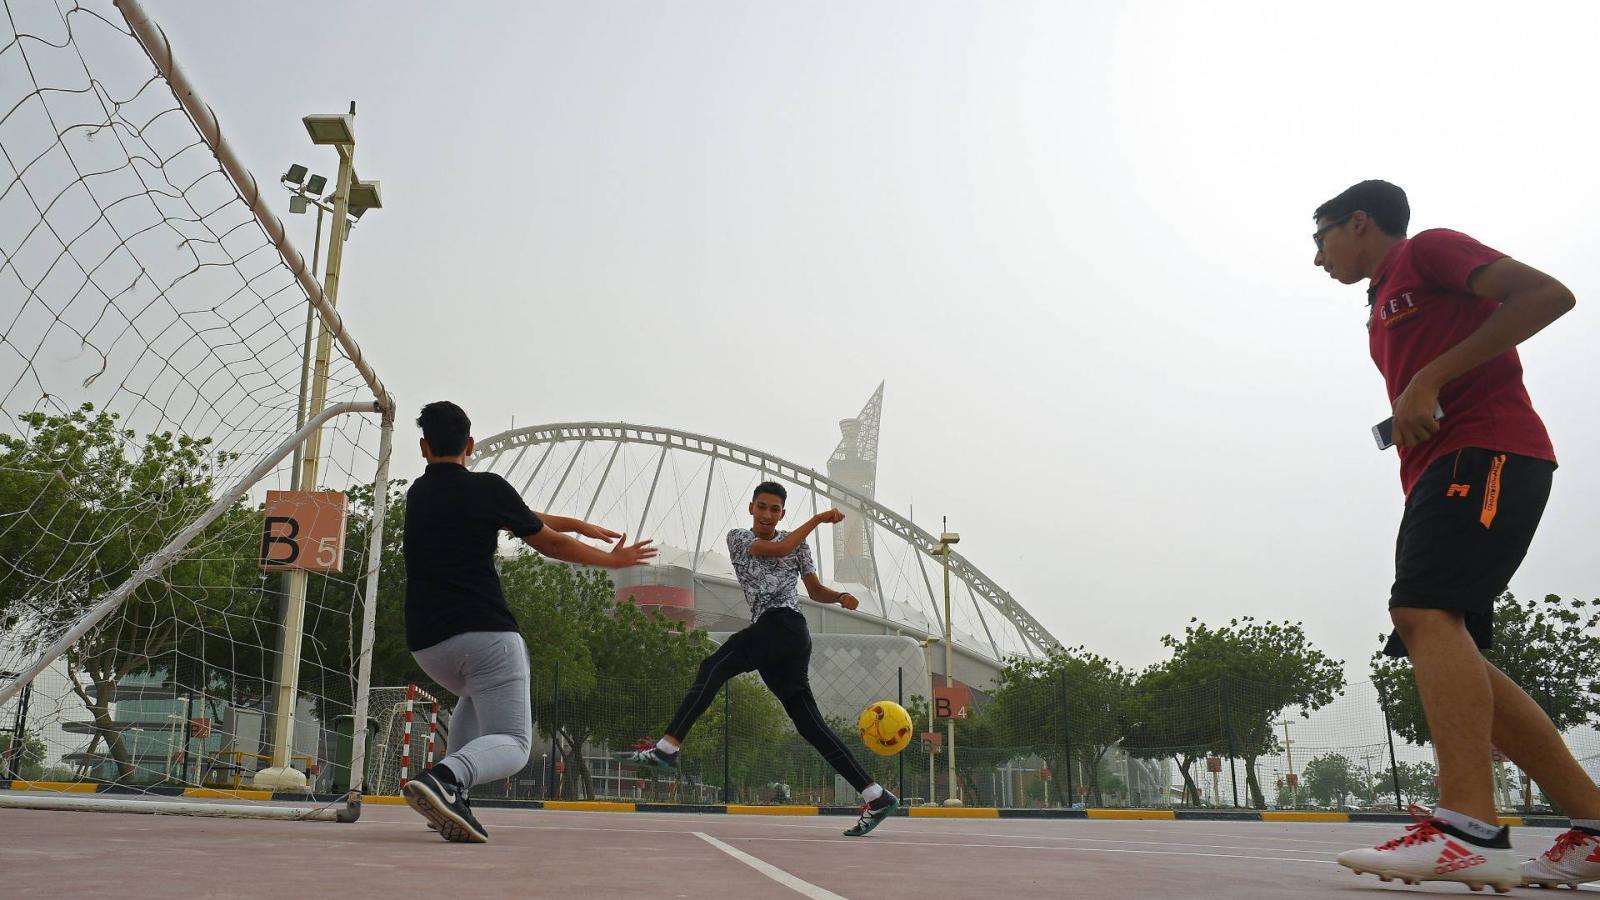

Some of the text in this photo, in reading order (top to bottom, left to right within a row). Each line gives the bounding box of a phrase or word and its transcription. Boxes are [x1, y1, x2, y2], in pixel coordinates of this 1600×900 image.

[260, 516, 337, 567] B 5
[935, 698, 967, 719] B 4
